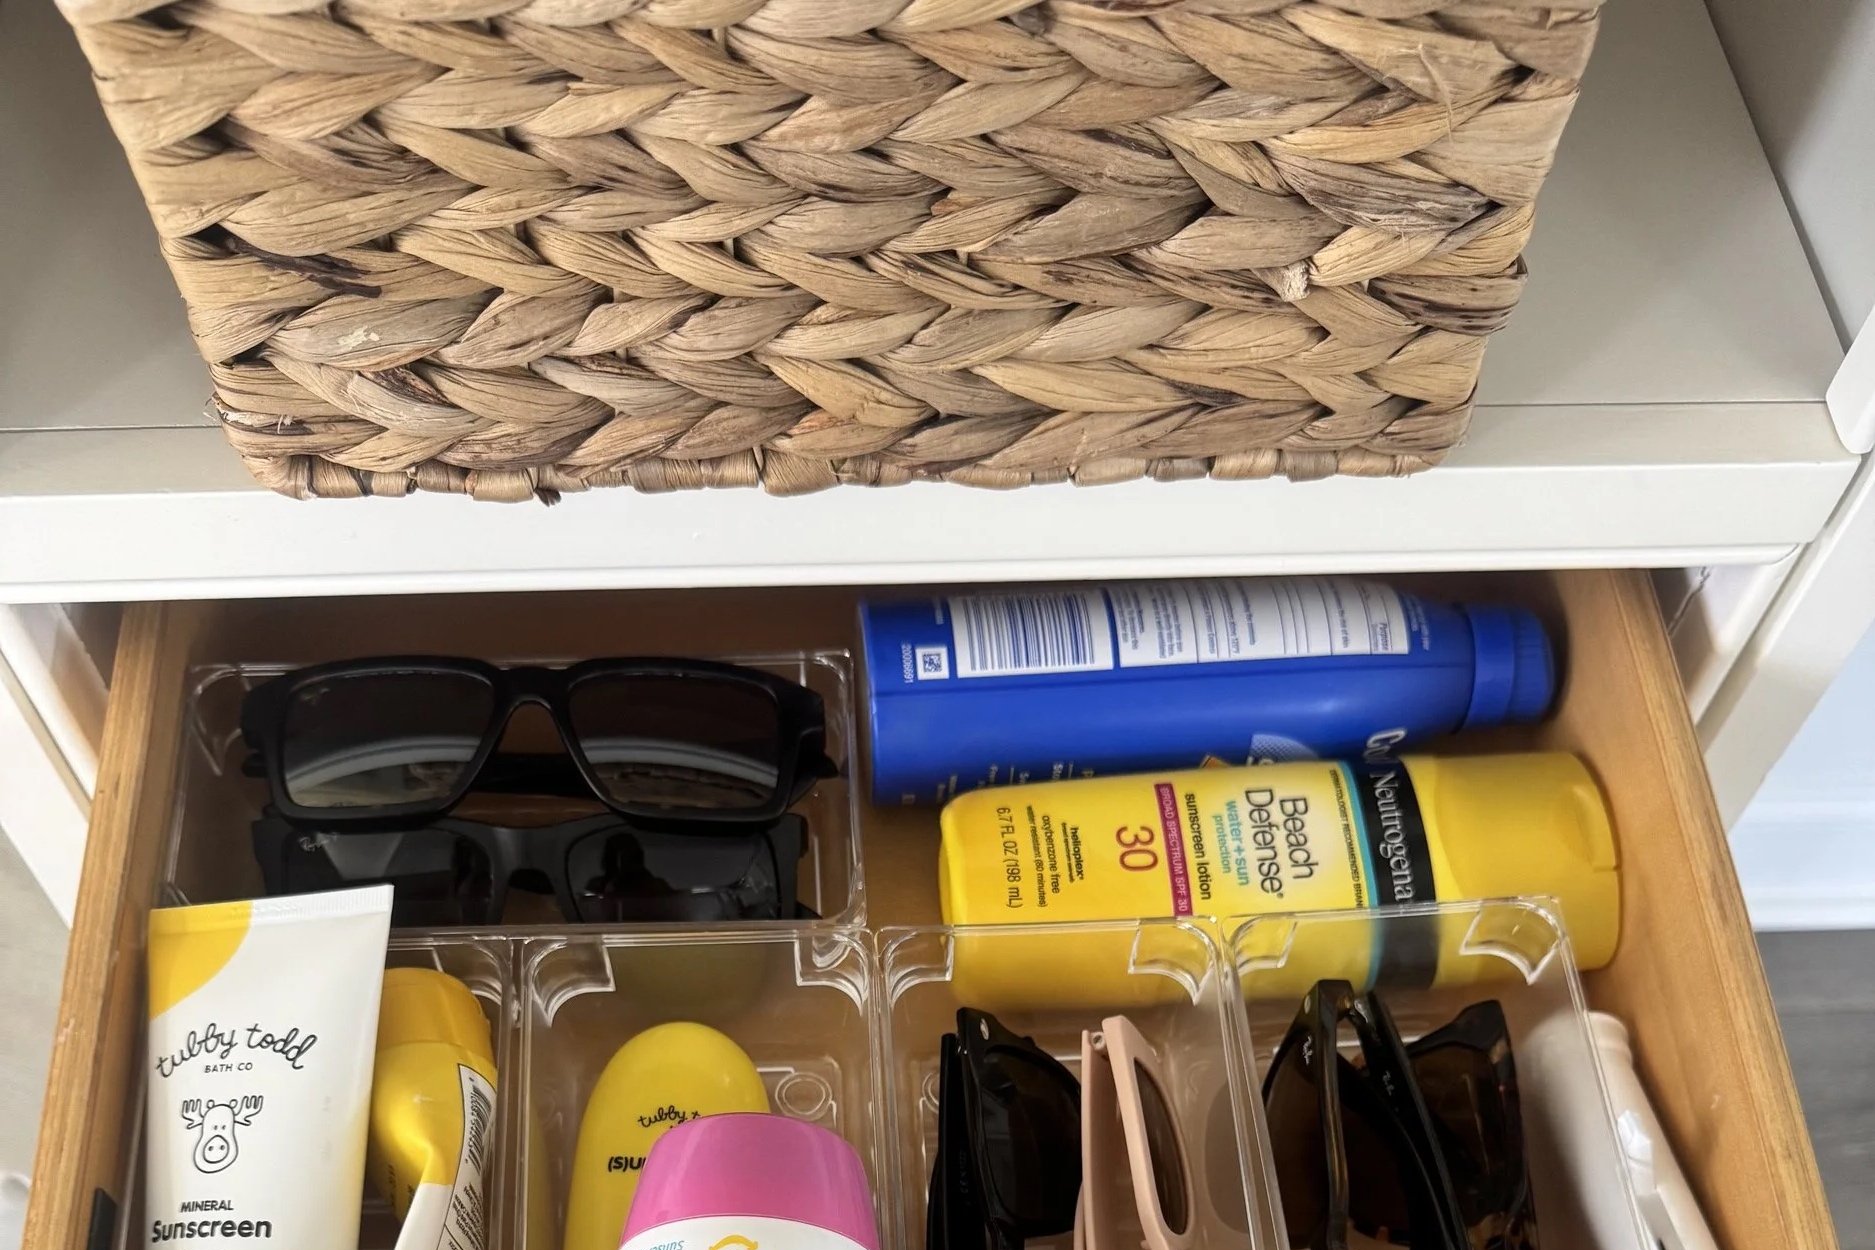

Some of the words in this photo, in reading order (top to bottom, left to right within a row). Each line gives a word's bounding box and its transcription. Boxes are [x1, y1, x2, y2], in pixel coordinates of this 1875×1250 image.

[996, 807, 1013, 823] 6.7
[1160, 786, 1174, 819] BROAD
[1001, 826, 1015, 838] FL
[1030, 825, 1041, 859] resistant
[1212, 815, 1232, 874] protection
[1279, 797, 1319, 879] Beach
[1369, 769, 1415, 903] Neutrogena
[1003, 840, 1018, 856] OZ
[1042, 815, 1058, 872] oxybenzone
[1050, 873, 1061, 894] free
[1115, 825, 1159, 872] 30
[1166, 820, 1184, 874] SPECTRUM
[1185, 793, 1206, 859] sunscreen
[1197, 861, 1212, 900] lotion
[1342, 823, 1360, 882] RECOMMENDED
[1003, 859, 1021, 883] (198
[1034, 859, 1044, 872] (80
[1006, 887, 1023, 909] mL)
[1037, 873, 1048, 908] minutes)
[1175, 876, 1186, 895] SPF
[1178, 896, 1188, 912] 30
[156, 1022, 238, 1078] tubby
[246, 1023, 318, 1070] todd
[204, 1064, 233, 1074] BATH
[238, 1062, 253, 1071] CO
[637, 1105, 688, 1128] tubby
[180, 1199, 234, 1213] MINERAL
[151, 1219, 272, 1243] Sunscreen
